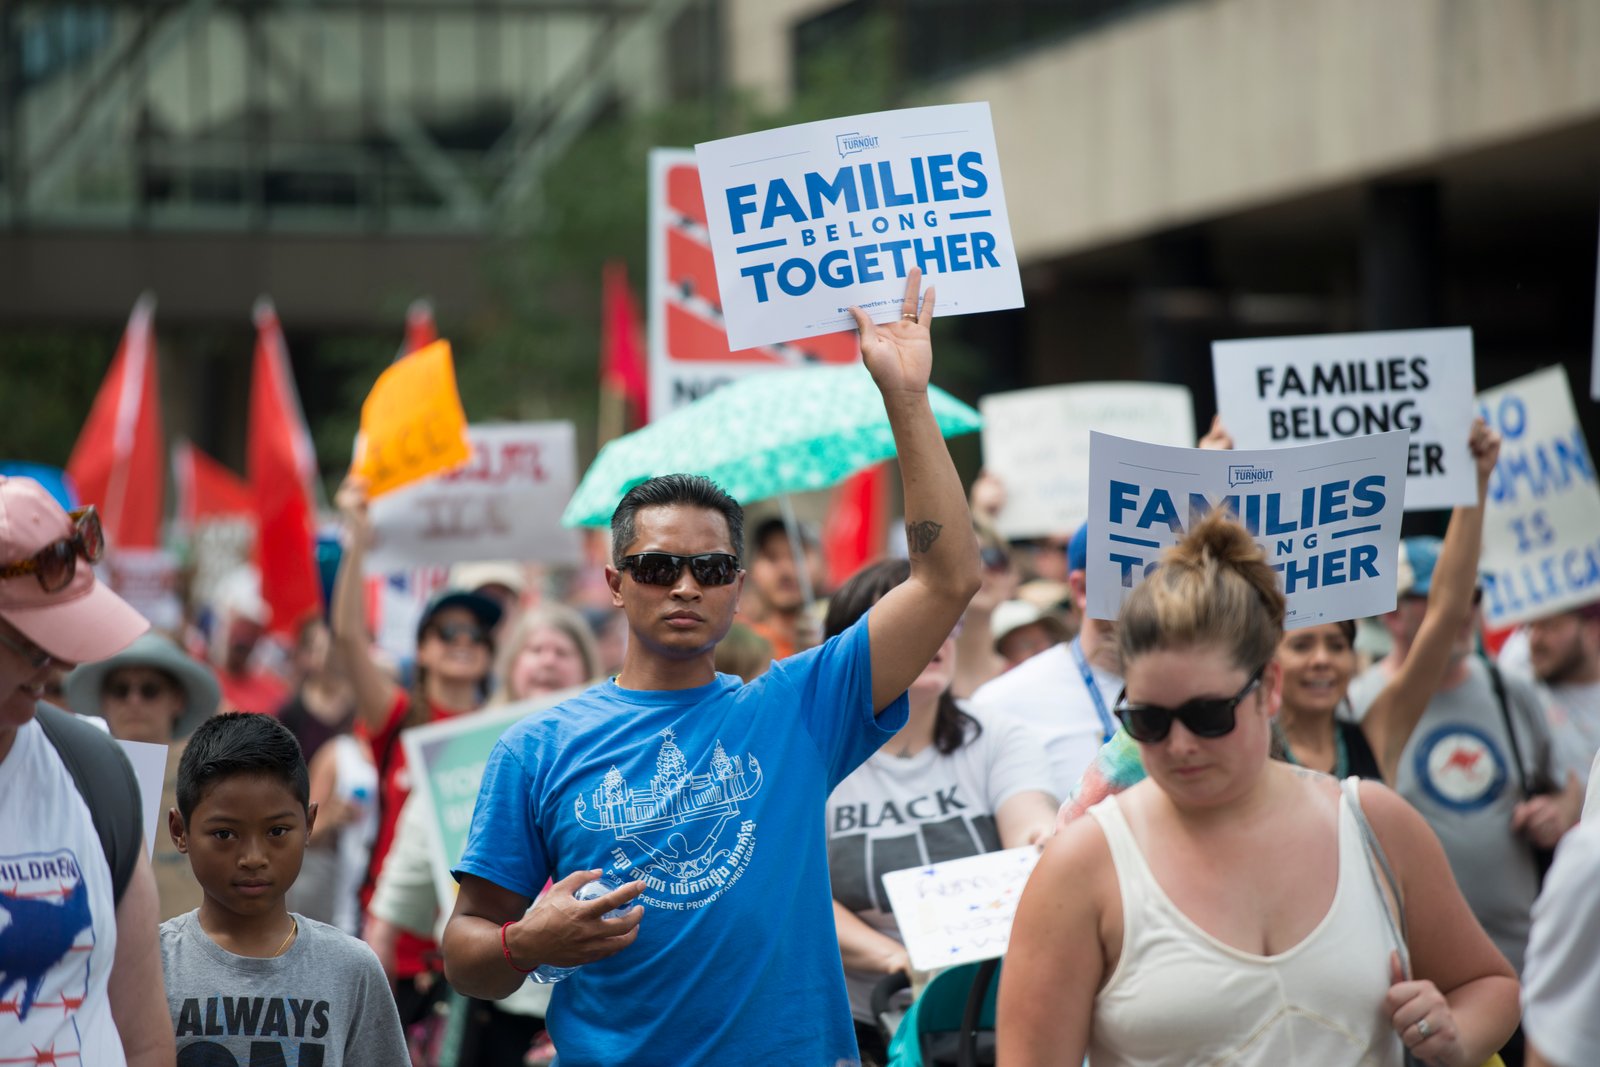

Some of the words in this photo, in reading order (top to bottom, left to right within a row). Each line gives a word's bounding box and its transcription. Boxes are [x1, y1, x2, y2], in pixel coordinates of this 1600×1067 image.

[842, 136, 879, 150] TURNOUT
[725, 151, 989, 235] FAMILIES
[801, 210, 938, 247] BELONG
[740, 231, 1001, 303] TOGETHER
[1256, 357, 1430, 399] FAMILIES
[1269, 400, 1423, 442] BELONG
[1235, 470, 1274, 480] TURNOUT
[1109, 475, 1387, 538] FAMILIES
[833, 785, 968, 834] BLACK
[0, 856, 78, 882] HILDREN
[637, 893, 684, 911] PRESERVE
[742, 835, 757, 867] LEGACY
[176, 996, 330, 1039] ALWAYS
